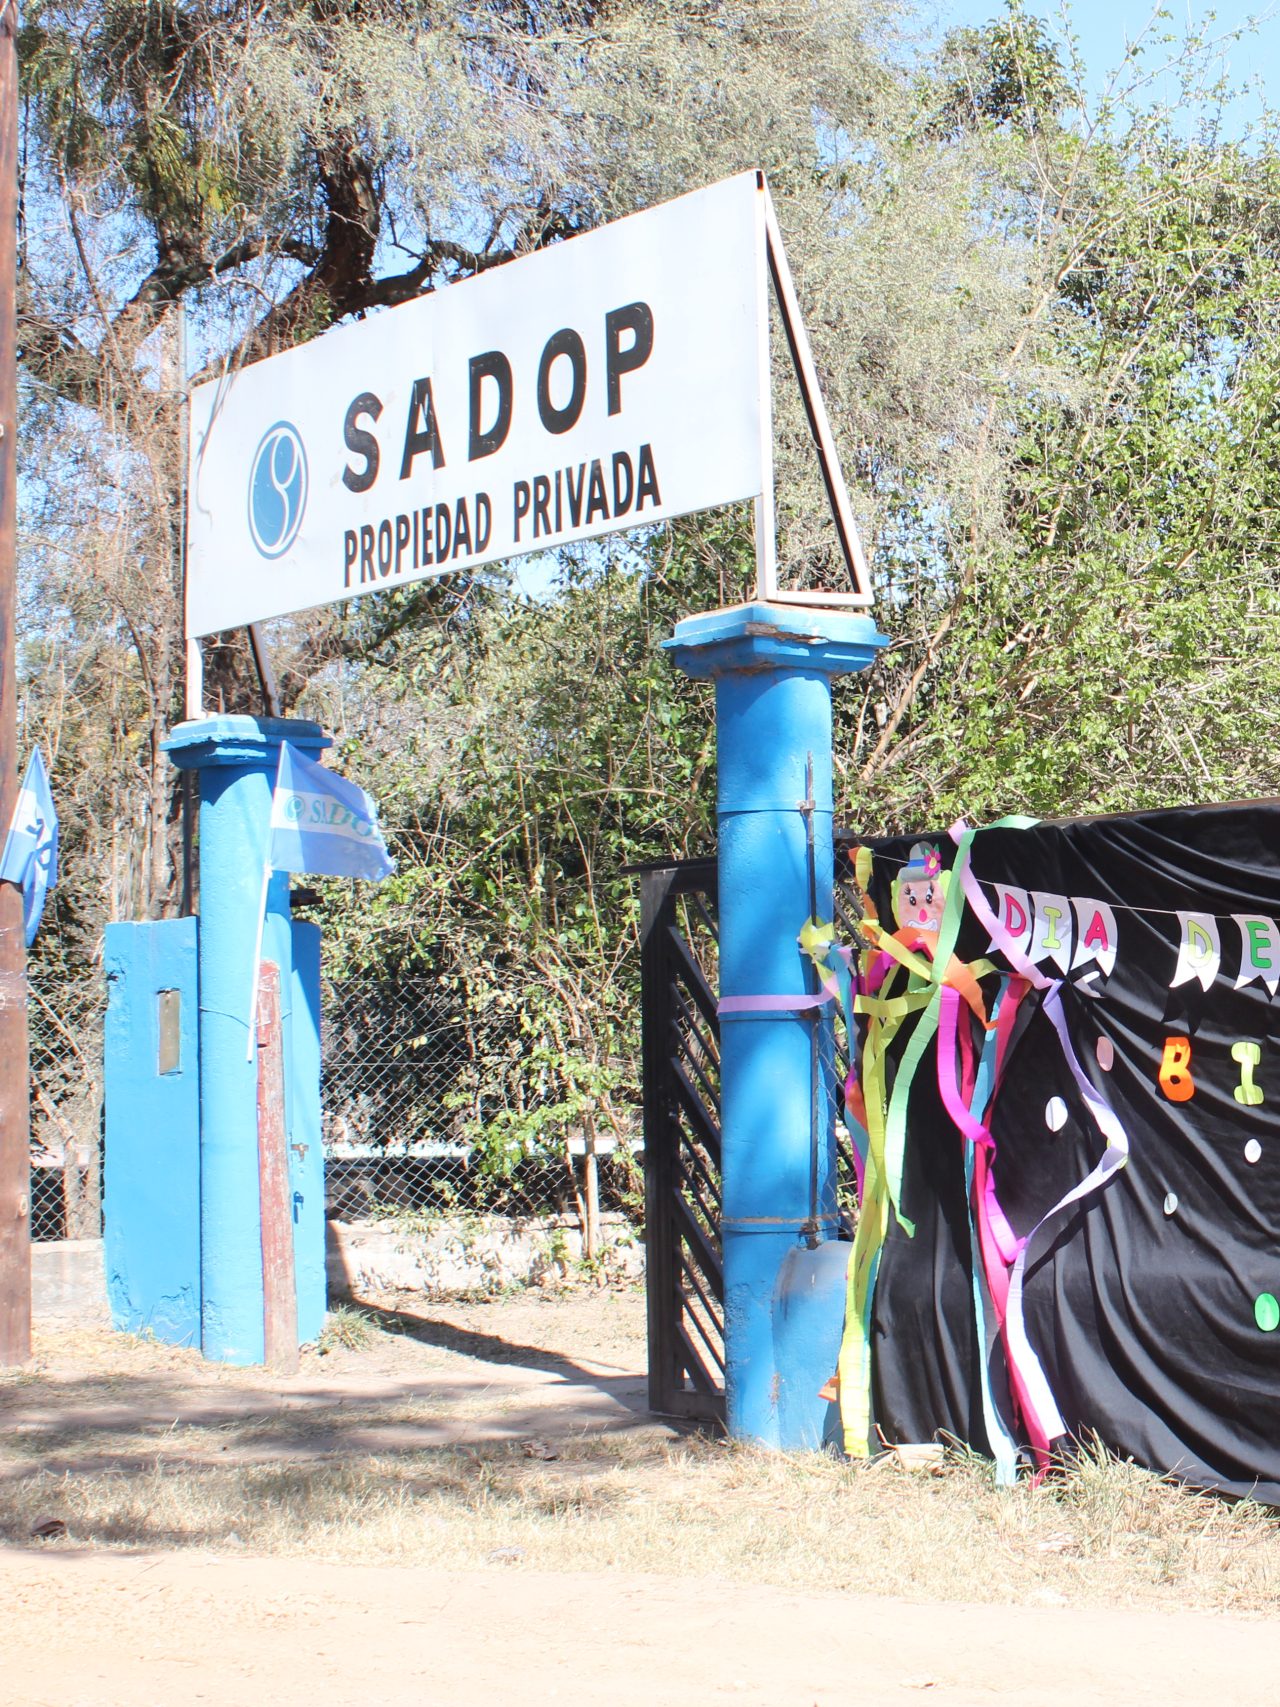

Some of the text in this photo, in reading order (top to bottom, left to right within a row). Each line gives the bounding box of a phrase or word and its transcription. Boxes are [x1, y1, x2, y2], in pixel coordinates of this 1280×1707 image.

[342, 301, 655, 493] SADOP
[343, 443, 662, 588] PROPIEDAD PRIVADA
[1004, 892, 1109, 952] DIA
[1186, 919, 1273, 969] DE
